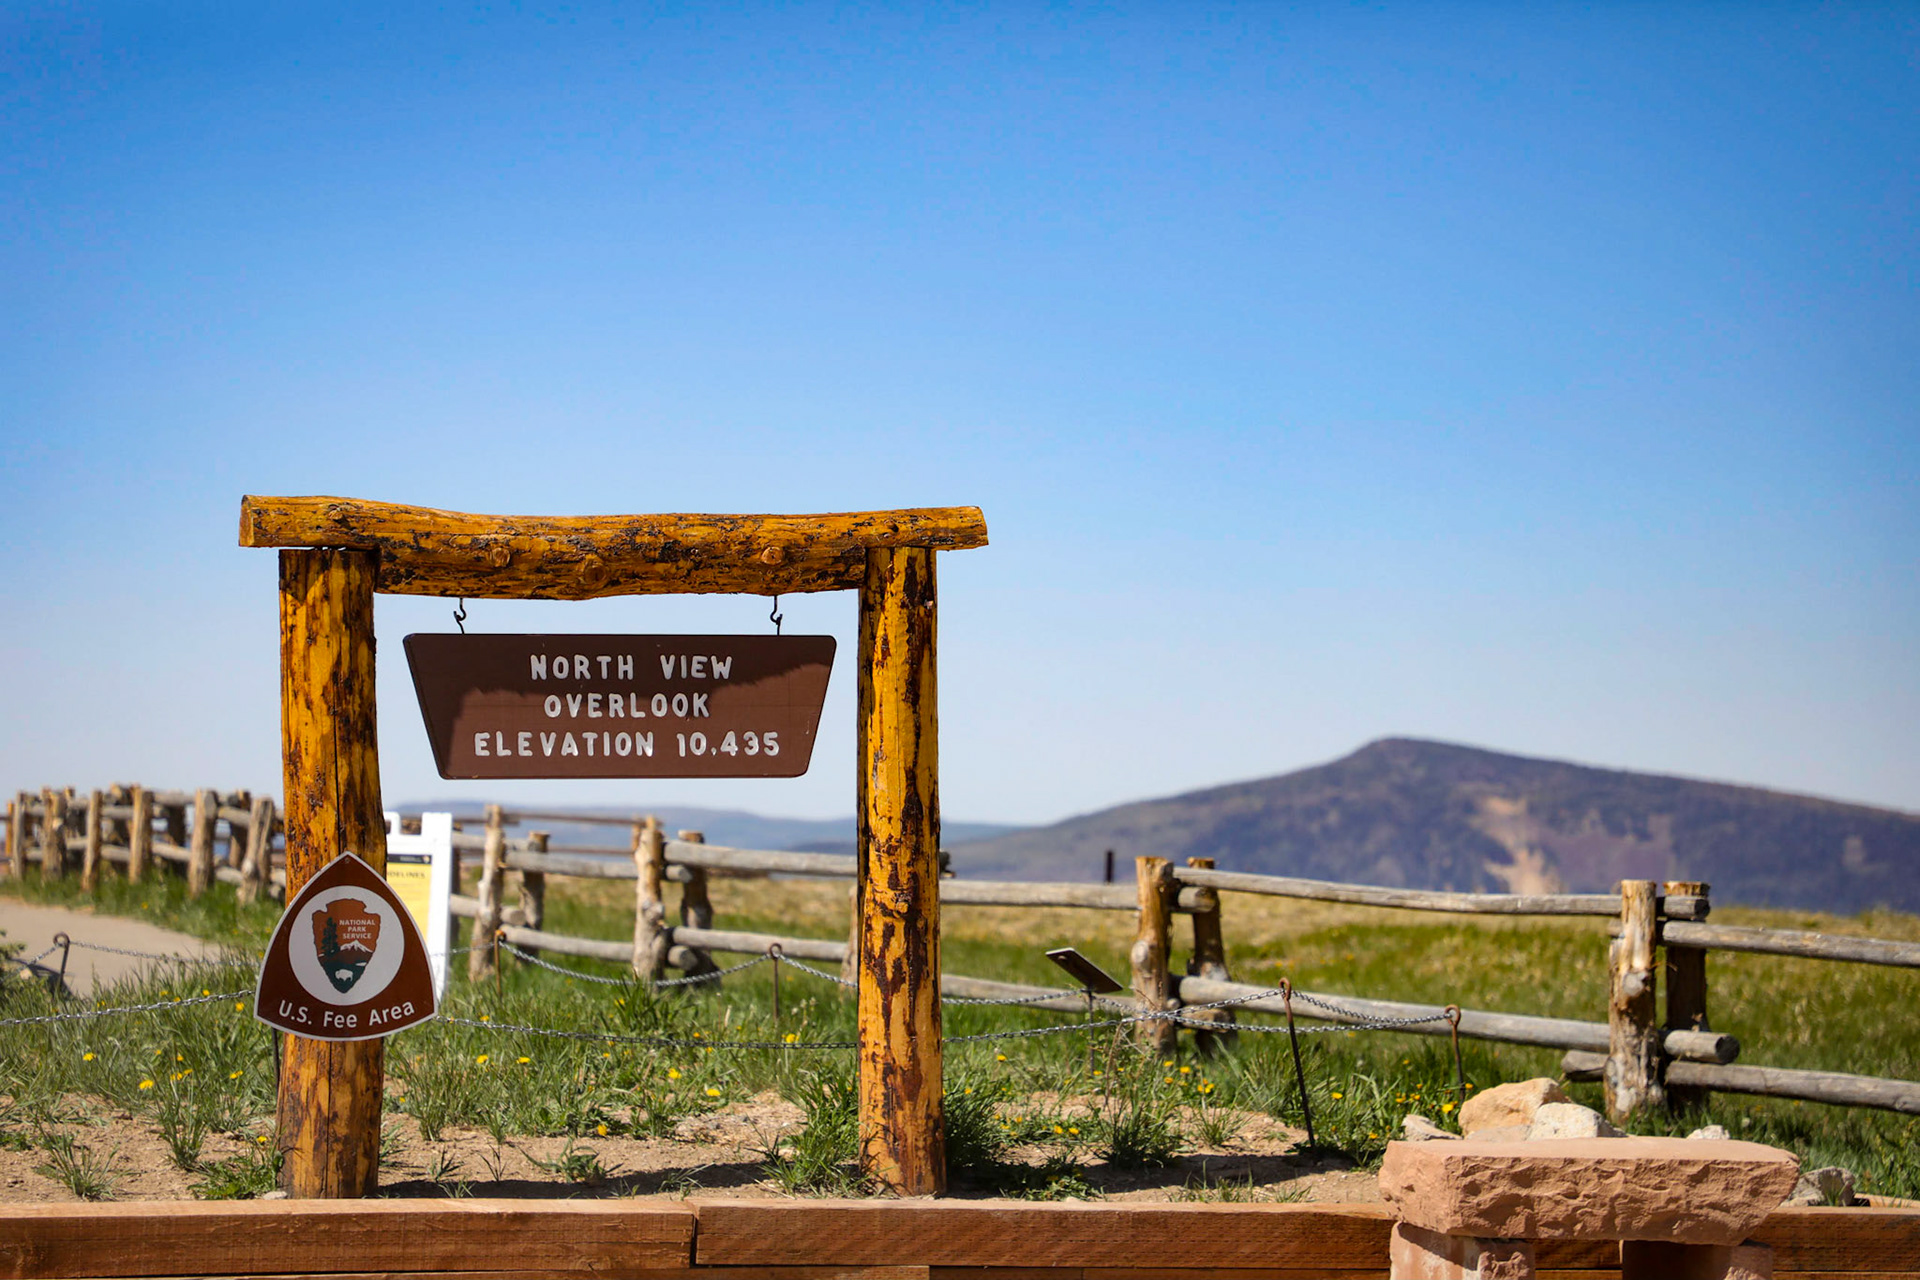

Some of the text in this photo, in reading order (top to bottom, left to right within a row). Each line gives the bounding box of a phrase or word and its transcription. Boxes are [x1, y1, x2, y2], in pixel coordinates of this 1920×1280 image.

[530, 654, 733, 680] NORTH VIEW
[544, 693, 710, 719] OVERLOOK
[474, 731, 655, 757] ELEVATION
[342, 932, 372, 940] SERVICE
[278, 999, 415, 1028] U.S. Fee Area
